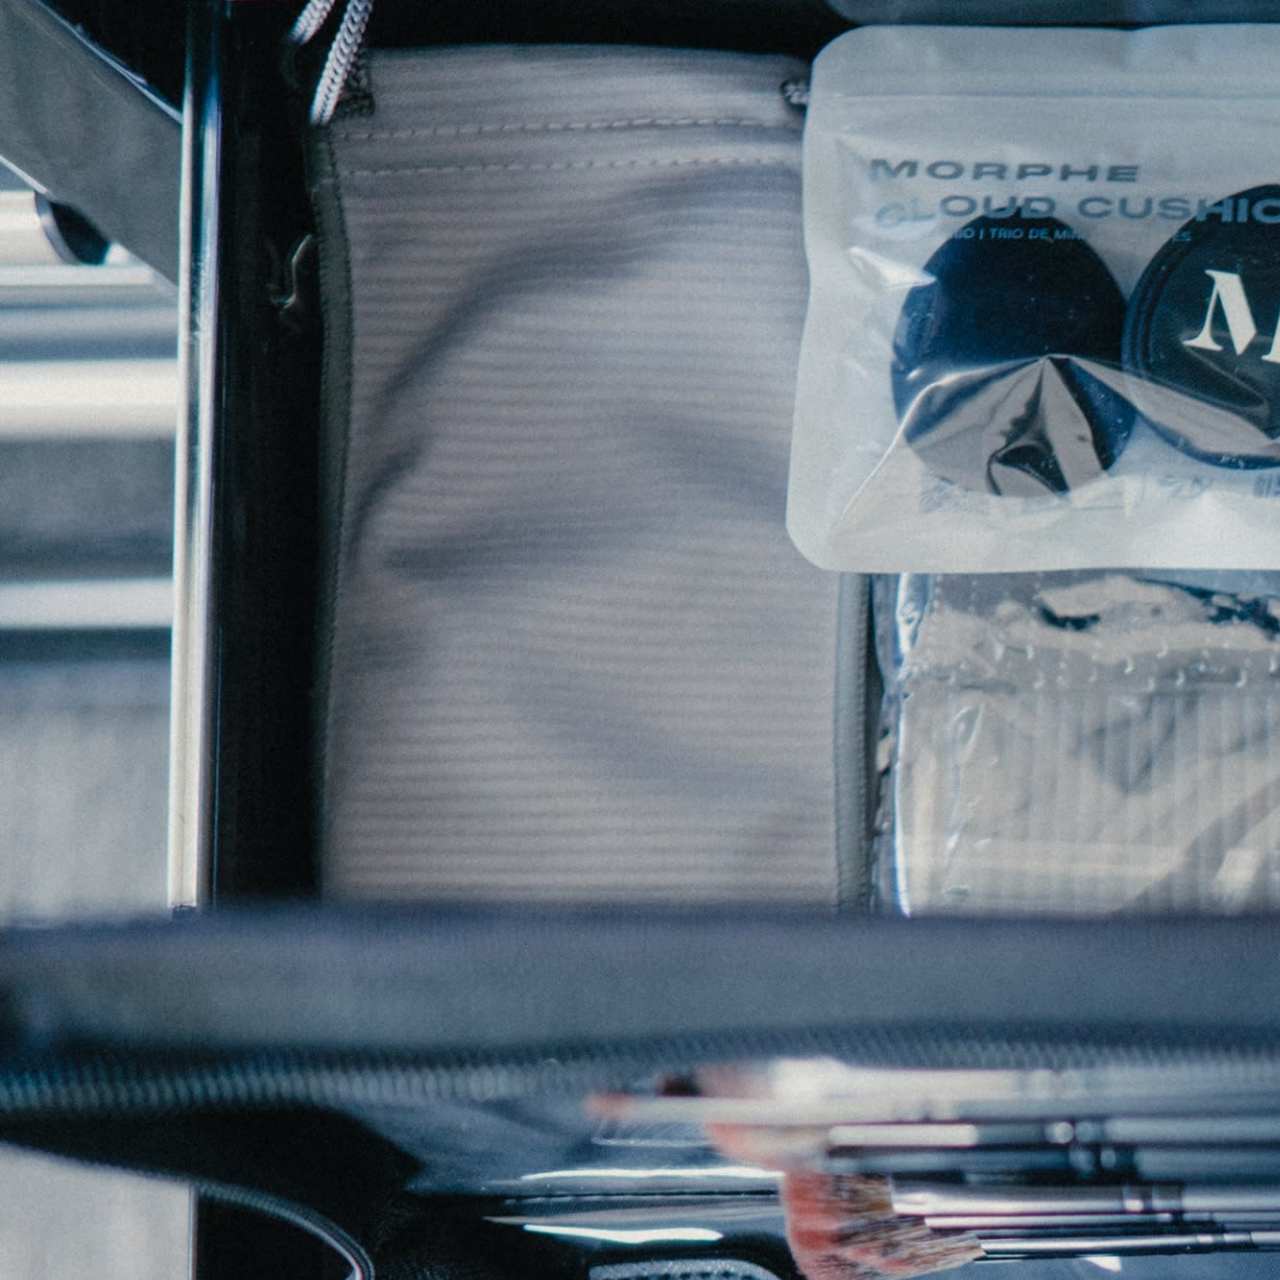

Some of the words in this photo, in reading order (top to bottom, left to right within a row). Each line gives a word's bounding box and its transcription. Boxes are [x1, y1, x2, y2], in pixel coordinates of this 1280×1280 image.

[869, 159, 1140, 183] MORPHE
[876, 195, 1056, 228] CLOUD
[989, 227, 1023, 241] TRIO
[1028, 227, 1049, 241] DE
